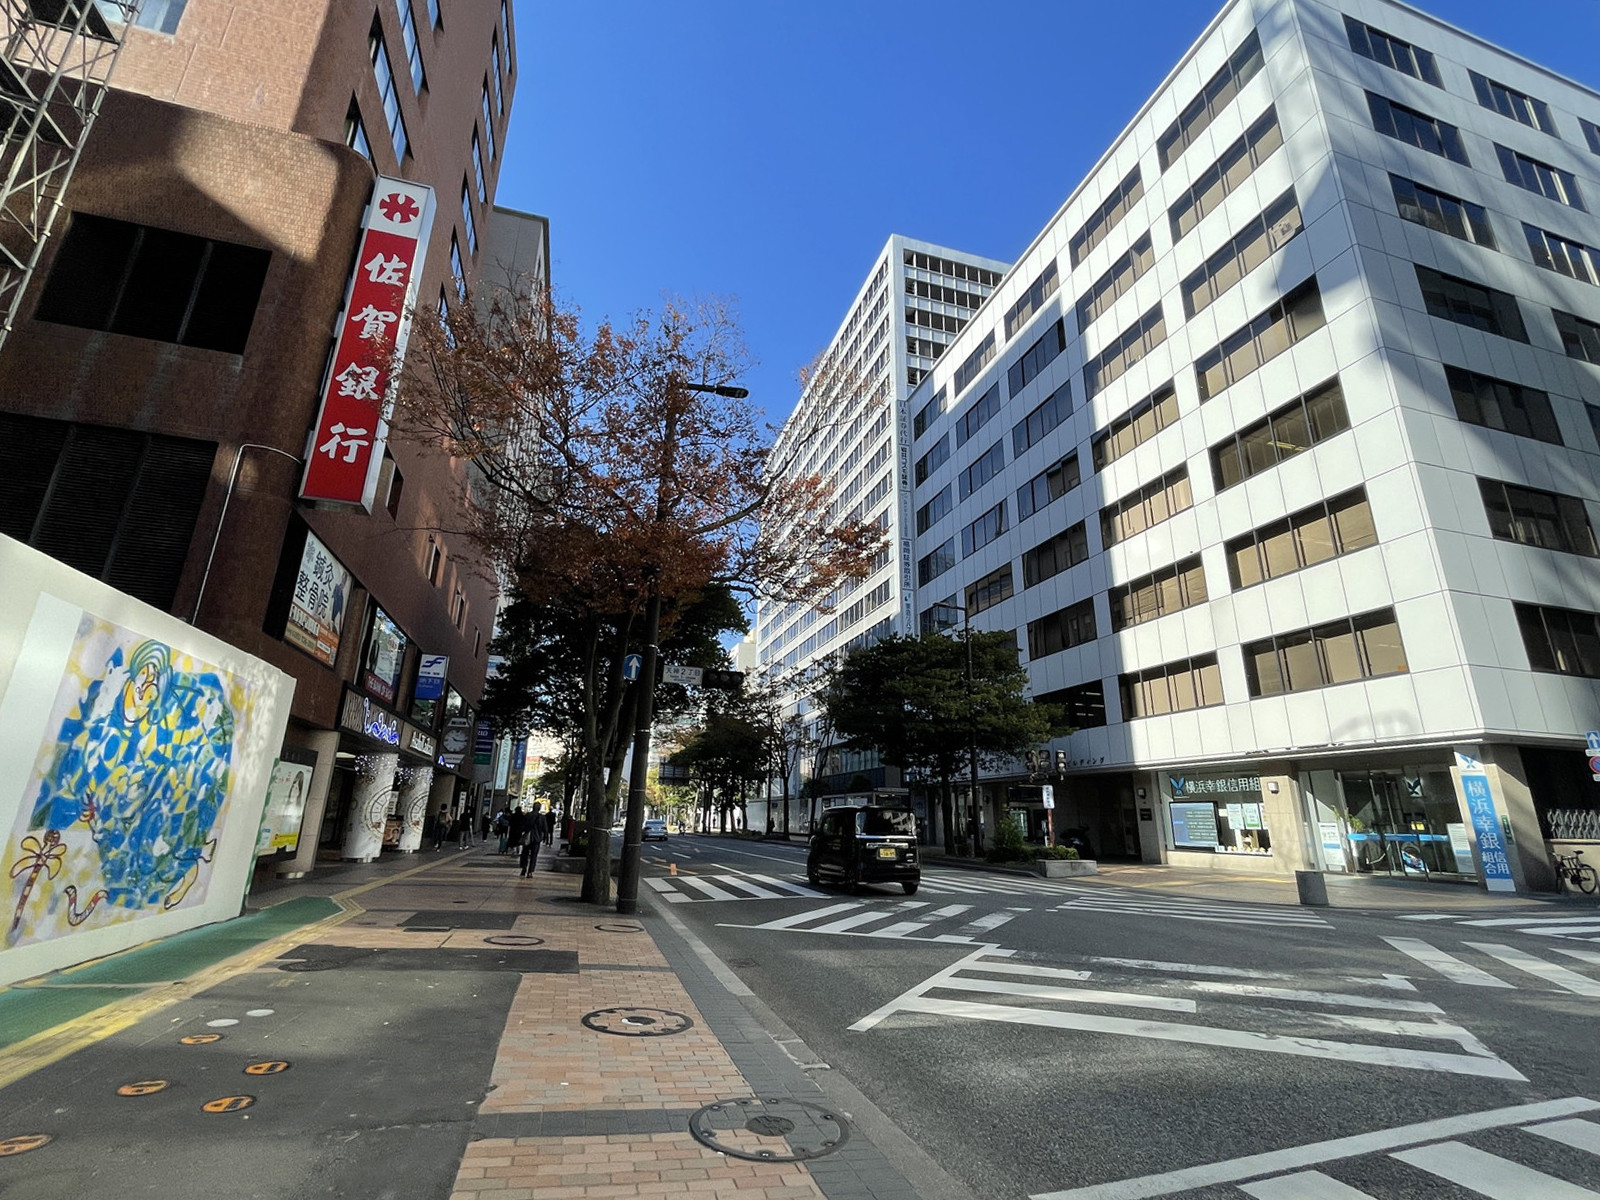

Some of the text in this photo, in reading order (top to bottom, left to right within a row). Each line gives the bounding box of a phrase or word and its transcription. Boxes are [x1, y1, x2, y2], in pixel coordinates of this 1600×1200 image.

[319, 252, 408, 464] 佐賀銀行
[902, 540, 912, 588] 福岡証券取引所
[295, 570, 330, 620] 整骨院
[665, 667, 701, 676] 天神2丁目
[1466, 780, 1502, 850] 横浜幸銀
